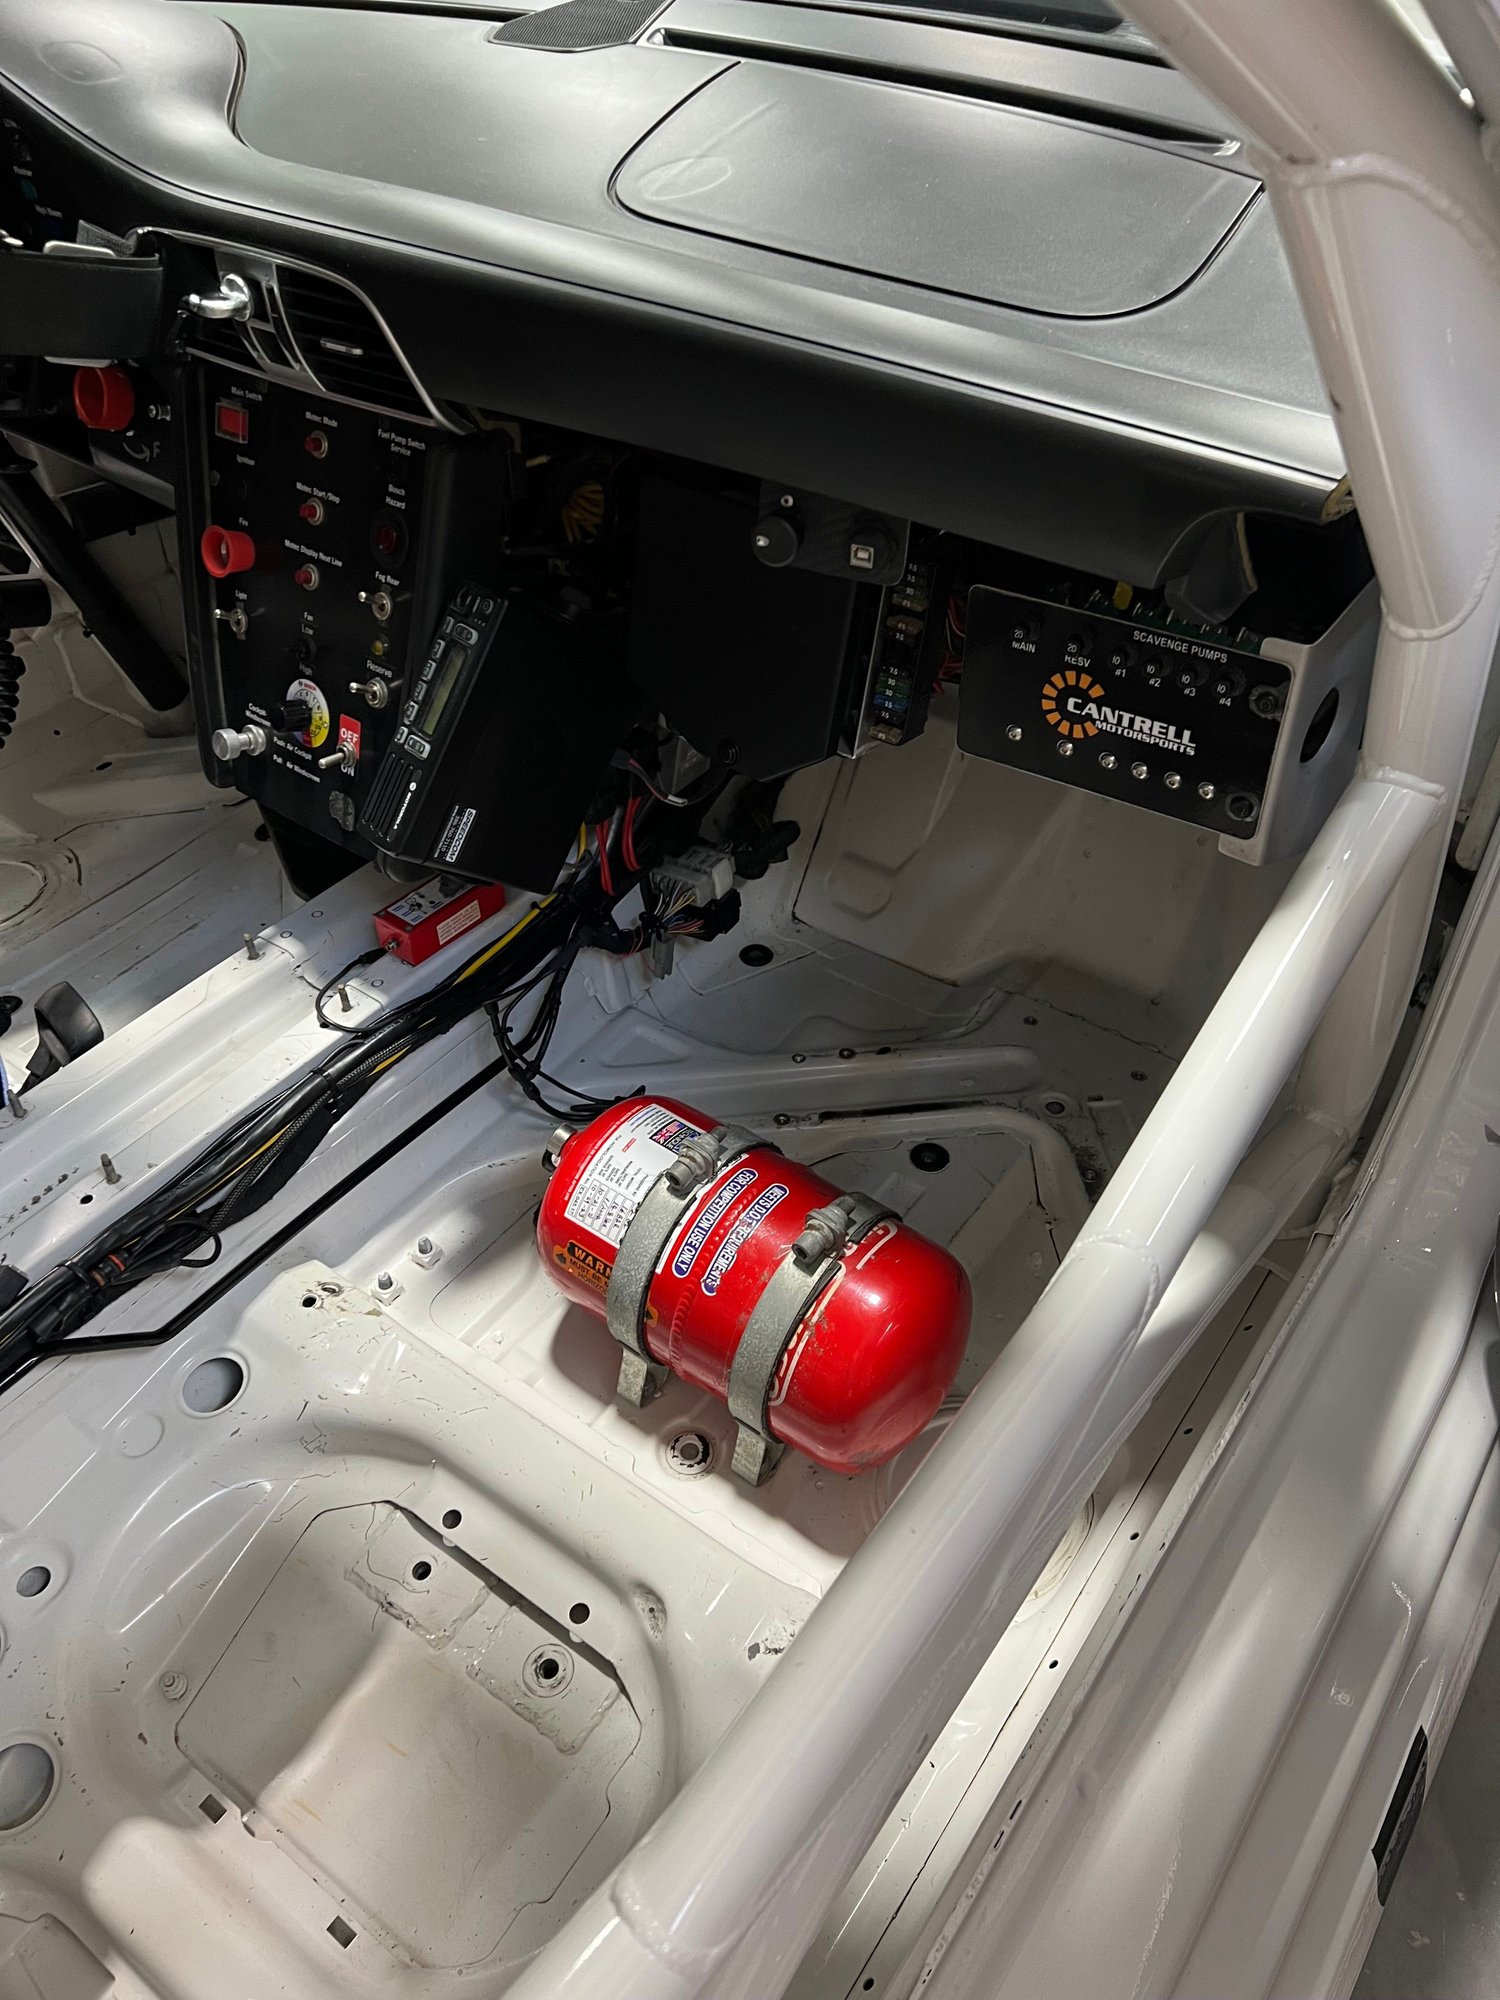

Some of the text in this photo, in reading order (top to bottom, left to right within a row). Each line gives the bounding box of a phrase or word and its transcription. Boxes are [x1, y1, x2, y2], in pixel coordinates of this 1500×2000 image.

[231, 386, 263, 401] Main Switch
[378, 428, 426, 451] Fuel Pump Switch
[390, 443, 411, 457] Service
[385, 495, 406, 510] Hazard
[238, 517, 249, 527] Fire
[300, 545, 318, 560] Display
[375, 571, 400, 586] Fog Rear
[303, 611, 314, 622] Fan
[301, 623, 314, 636] Low
[1013, 629, 1024, 640] 20
[1012, 640, 1036, 653] MAIN
[1066, 643, 1078, 654] 20
[1133, 630, 1228, 663] SCAVENGE PUMPS
[366, 658, 394, 679] Reserve
[1064, 654, 1091, 668] RESV
[1114, 667, 1127, 678] #1
[1149, 677, 1161, 687] #2
[1184, 687, 1196, 697] #3
[1219, 696, 1232, 707] #4
[1066, 697, 1197, 748] CANTRELL
[340, 727, 359, 744] OFF
[1095, 720, 1196, 757] MOTORSPORTS
[294, 746, 312, 761] Cockpit
[293, 764, 320, 784] Windscreen
[341, 764, 355, 777] ON
[393, 791, 412, 829] MOTOROLA
[449, 810, 474, 860] SPEEDCOM
[761, 1186, 785, 1209] MEETS
[676, 1171, 754, 1271] FOR COMPETITION USE ONLY
[705, 1223, 751, 1287] REQUIREMENTS
